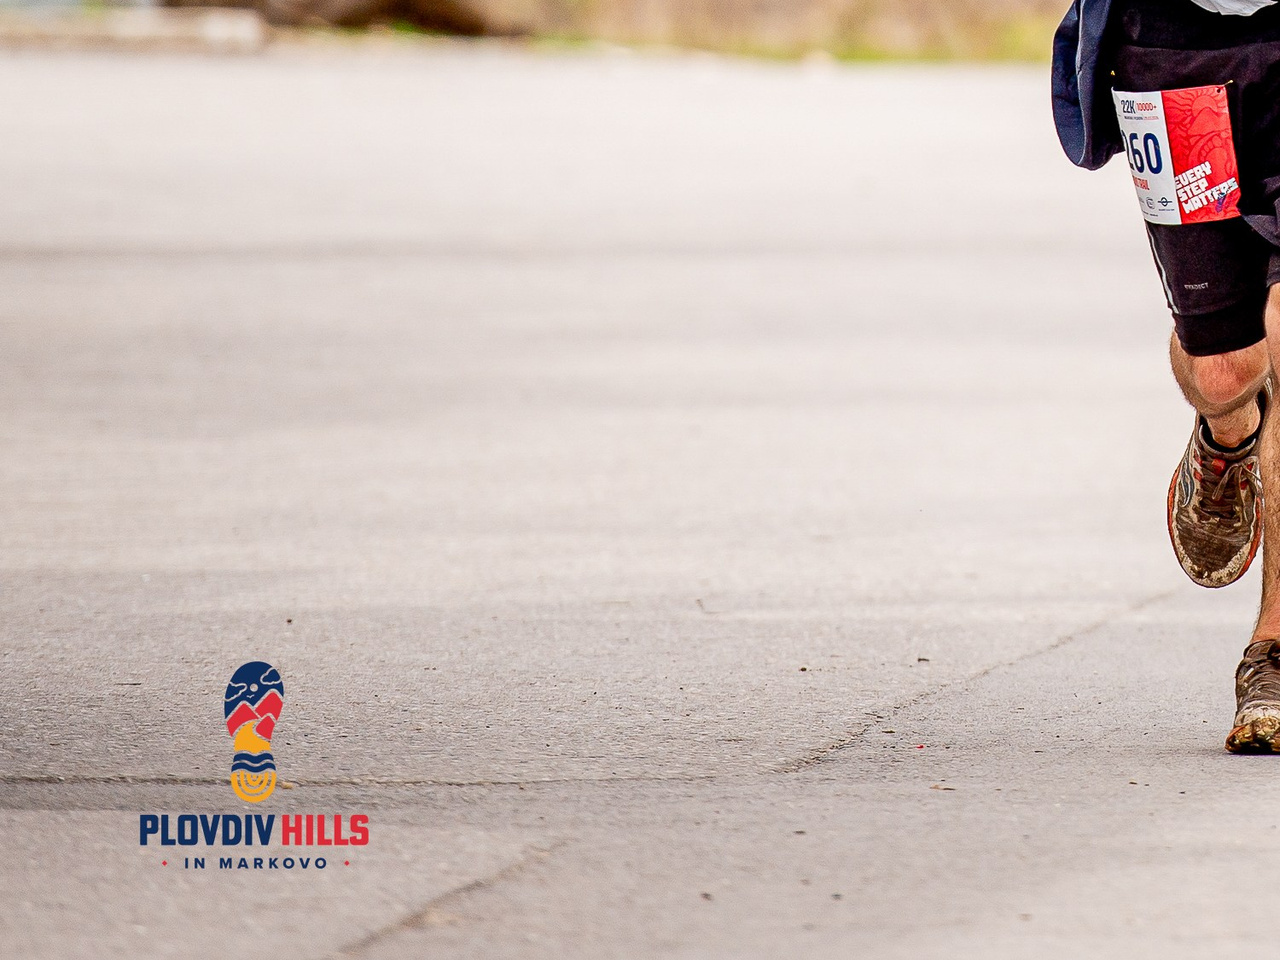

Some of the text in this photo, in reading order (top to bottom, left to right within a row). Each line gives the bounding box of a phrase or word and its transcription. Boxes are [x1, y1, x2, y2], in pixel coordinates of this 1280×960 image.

[1120, 100, 1136, 114] 22K
[1174, 161, 1212, 189] EVERY
[1177, 177, 1209, 202] STEP
